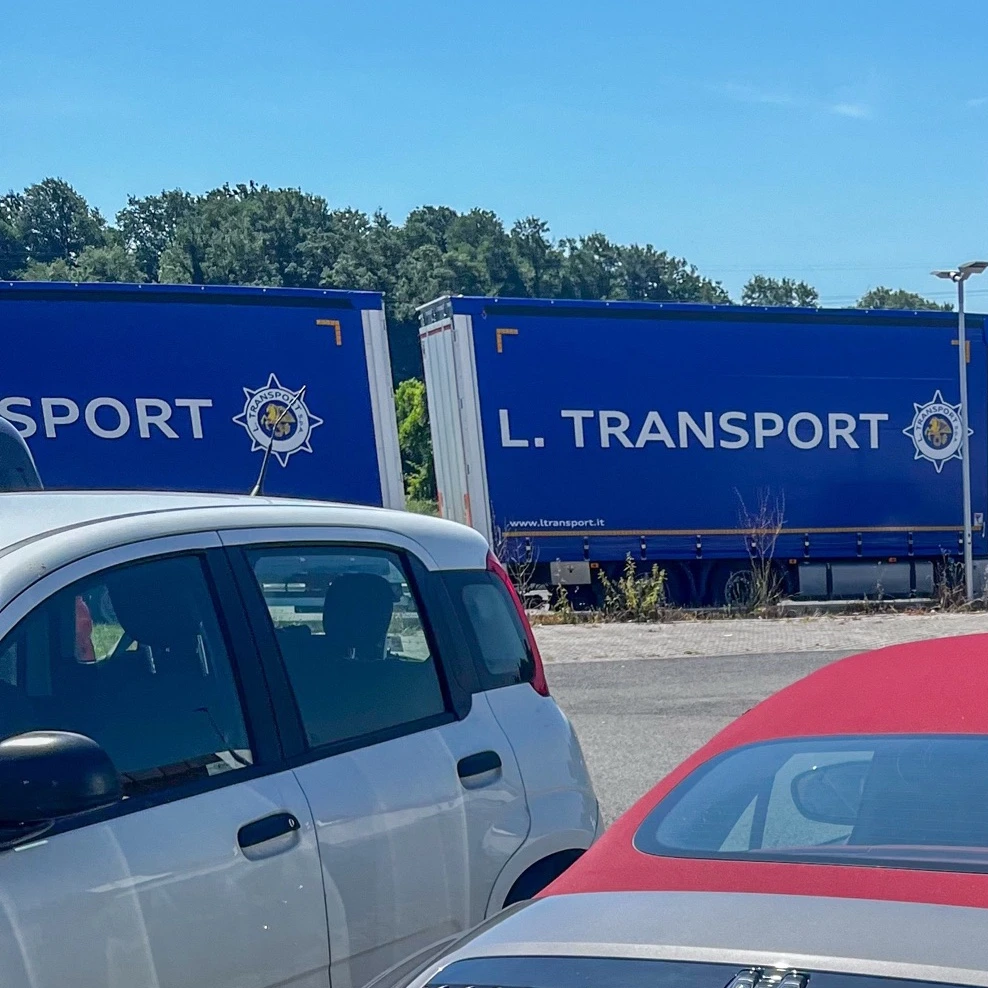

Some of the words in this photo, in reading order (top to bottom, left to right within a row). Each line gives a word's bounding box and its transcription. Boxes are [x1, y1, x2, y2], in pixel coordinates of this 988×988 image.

[500, 409, 545, 448] L.
[561, 409, 889, 449] TRANSPORT
[916, 405, 958, 431] TRANSPORT
[509, 519, 605, 529] www.ltransport.it
